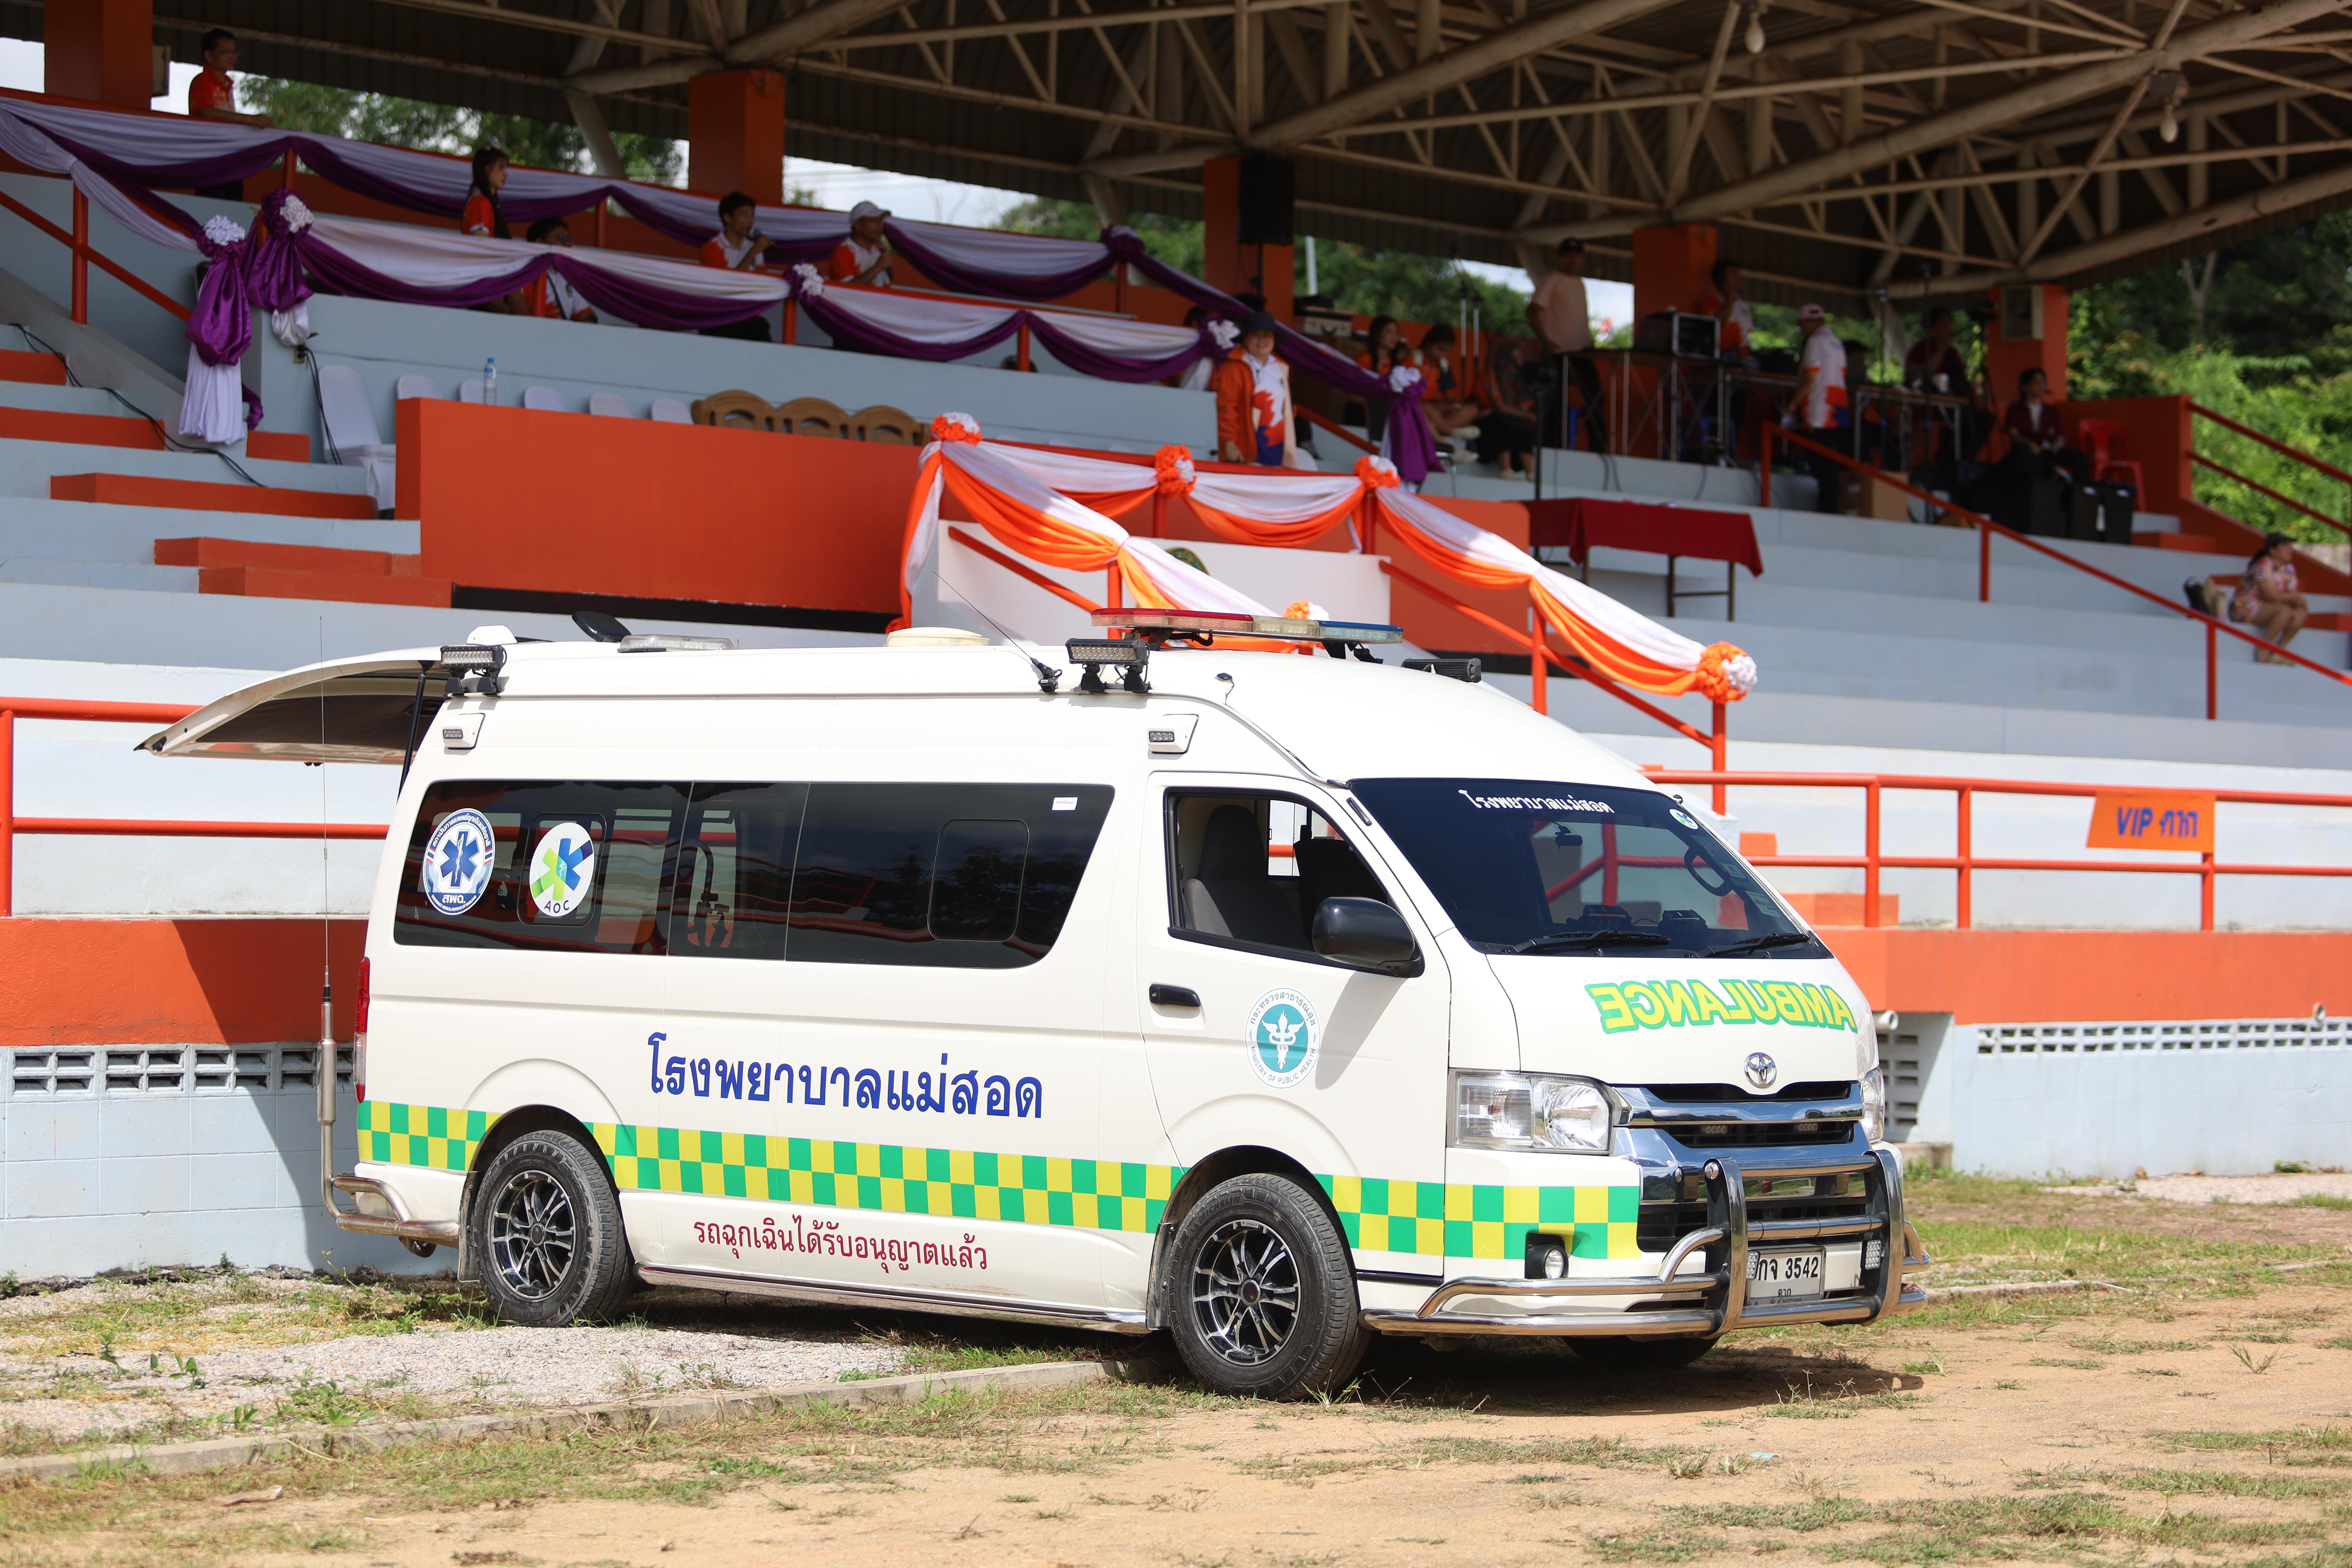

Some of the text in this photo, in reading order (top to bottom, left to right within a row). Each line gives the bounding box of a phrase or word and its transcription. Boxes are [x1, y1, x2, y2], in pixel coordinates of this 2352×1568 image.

[1458, 789, 1615, 813] โรงพยาบาลแม่สอด
[2118, 806, 2153, 836] VIP
[442, 894, 466, 903] สพฉ.
[544, 900, 570, 913] AOC
[1250, 992, 1316, 1026] กระทรวงสาธารณสุข
[648, 1032, 1043, 1119] โรงพยาบาลแม่สอด
[1251, 1046, 1267, 1076] MINISTRY
[1278, 1073, 1299, 1084] PUBLIC
[1300, 1048, 1316, 1075] HEALTH
[1199, 1195, 1240, 1223] MICHELIN
[694, 1214, 988, 1273] รถฉุกเฉินได้รับอนุญาตแล้ว
[1759, 1256, 1818, 1280] กจ 3542
